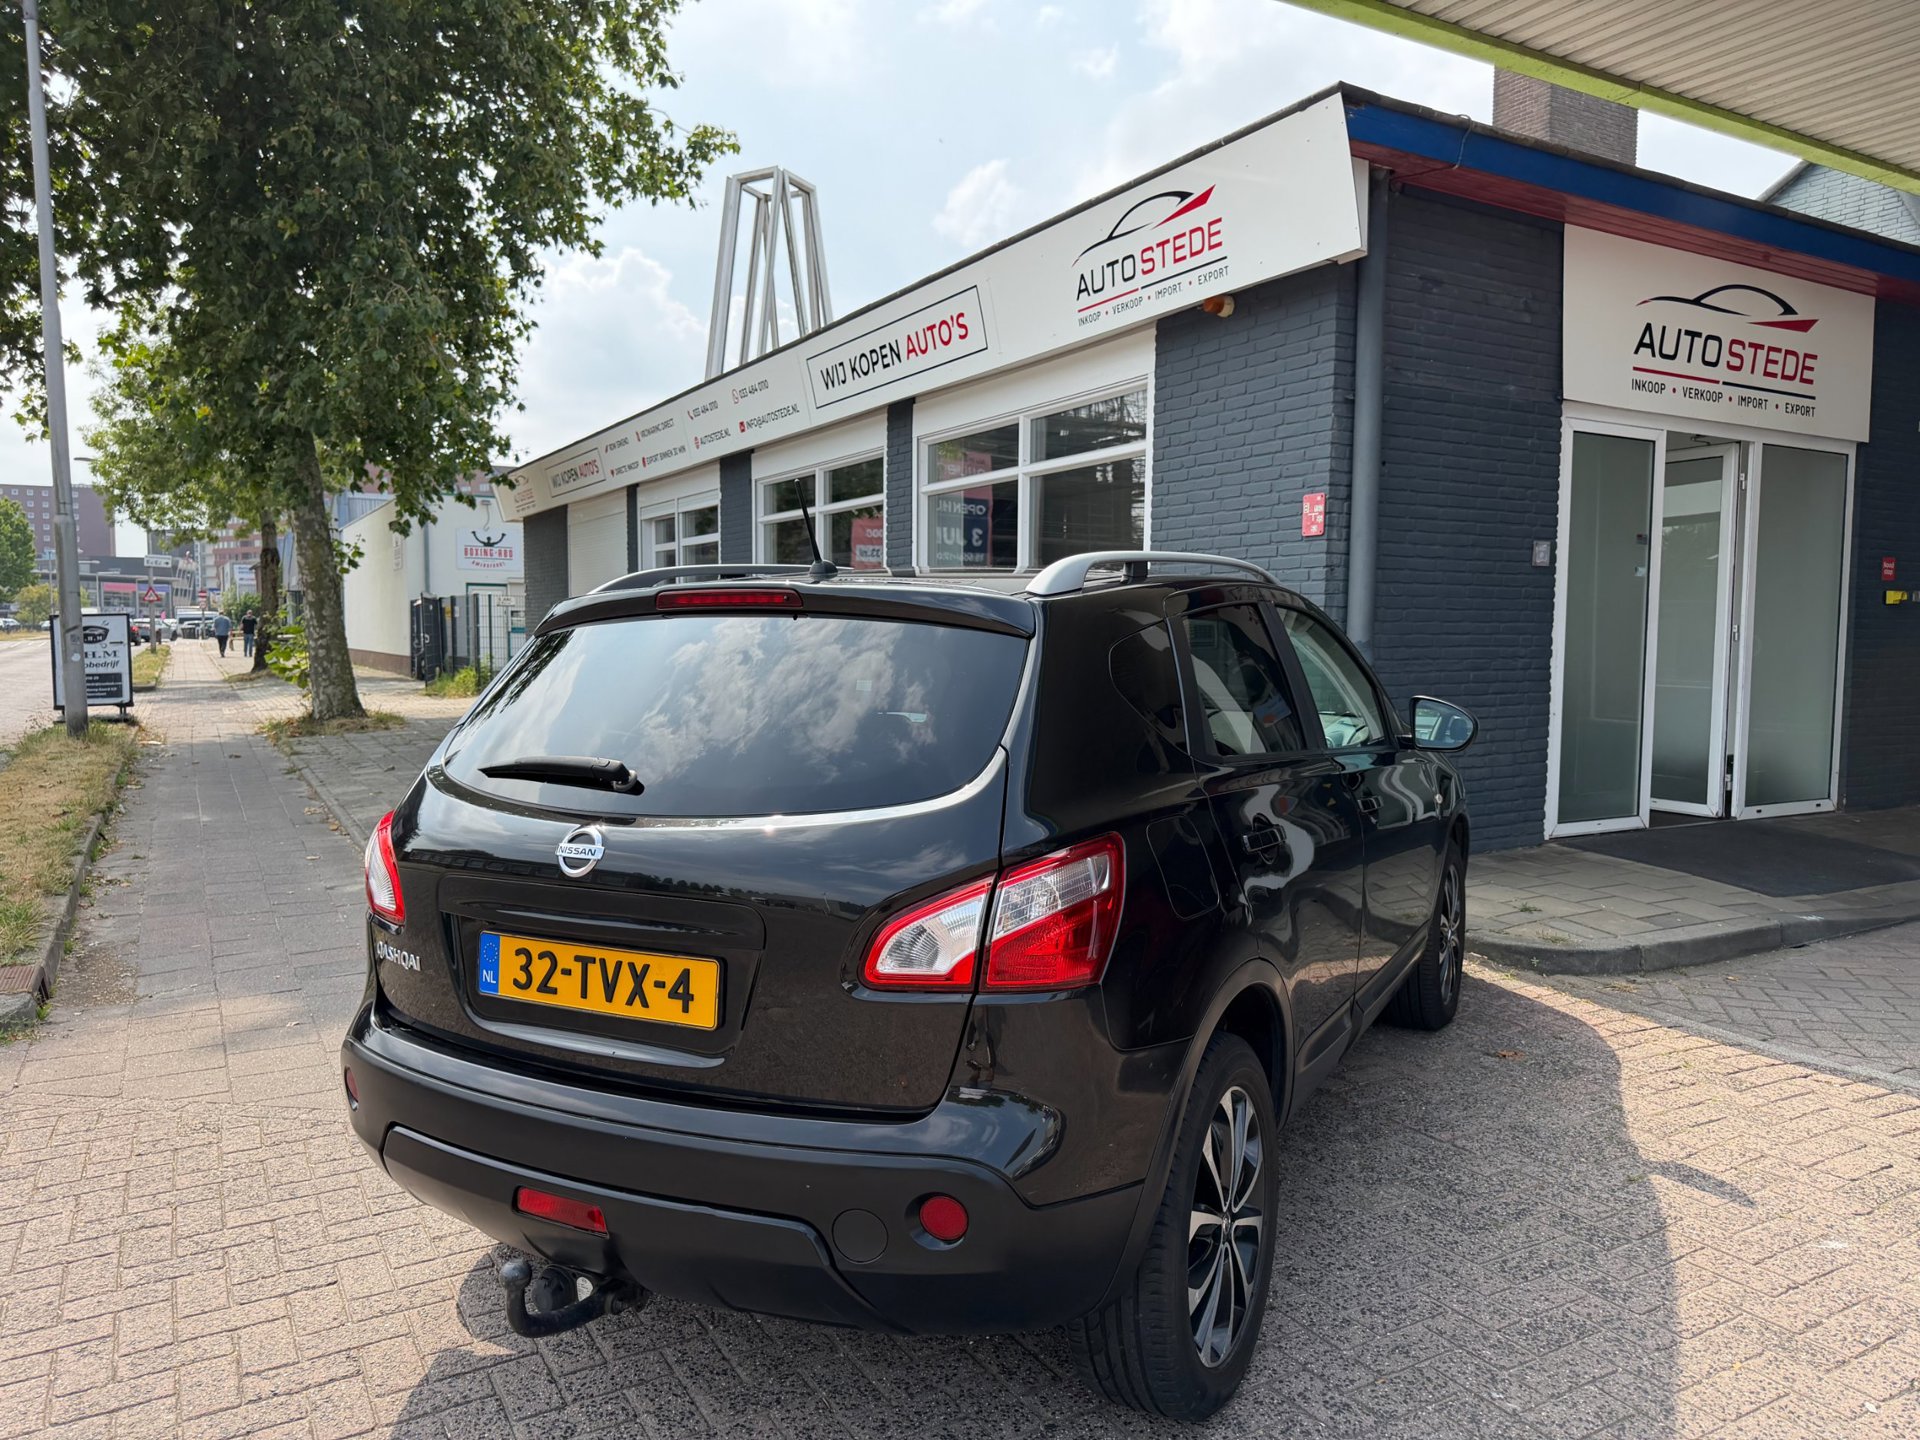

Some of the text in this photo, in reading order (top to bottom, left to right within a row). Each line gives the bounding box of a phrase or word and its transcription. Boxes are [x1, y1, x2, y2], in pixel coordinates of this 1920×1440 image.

[1078, 265, 1230, 326] INKOOP VERKOOP IMPORT EXPORT
[820, 311, 969, 390] WIJ KOPEN AUTO'S
[1631, 378, 1816, 417] INKOOP VERKOOP IMPORT EXPORT
[746, 403, 800, 429] INFO@AUTOSTEDE.NL
[561, 467, 579, 484] KOPEN
[578, 459, 599, 477] AUTO'S
[557, 845, 597, 857] NISSAN
[377, 941, 421, 972] QASHQAI
[482, 969, 497, 985] NL
[513, 947, 694, 1014] 32-TVX-4
